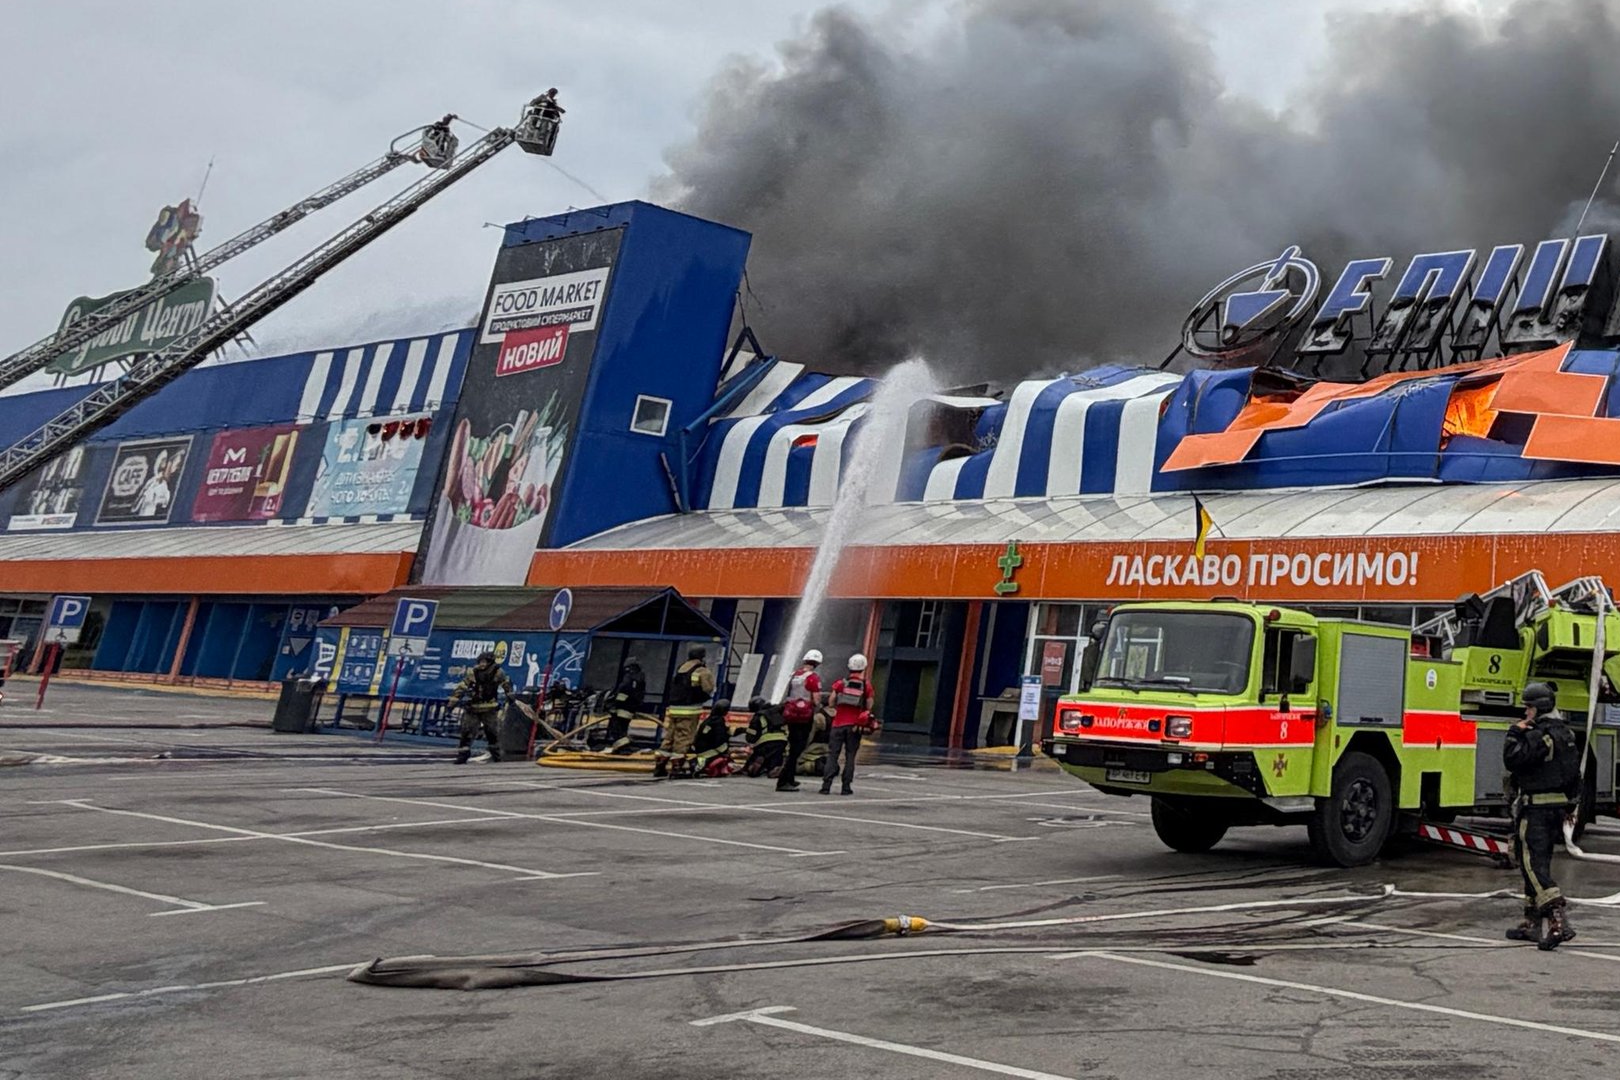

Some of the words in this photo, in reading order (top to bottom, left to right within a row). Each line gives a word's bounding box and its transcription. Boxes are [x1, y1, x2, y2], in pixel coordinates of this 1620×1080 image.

[494, 290, 538, 313] FOOD
[540, 280, 602, 307] MARKET
[503, 330, 564, 370] НОВИЙ
[1106, 554, 1242, 586] ЛАСКАВО
[1248, 552, 1419, 587] ПРОСИМО!
[58, 600, 82, 624] P
[403, 606, 429, 633] P
[1488, 654, 1502, 674] 8
[1280, 721, 1289, 739] 8
